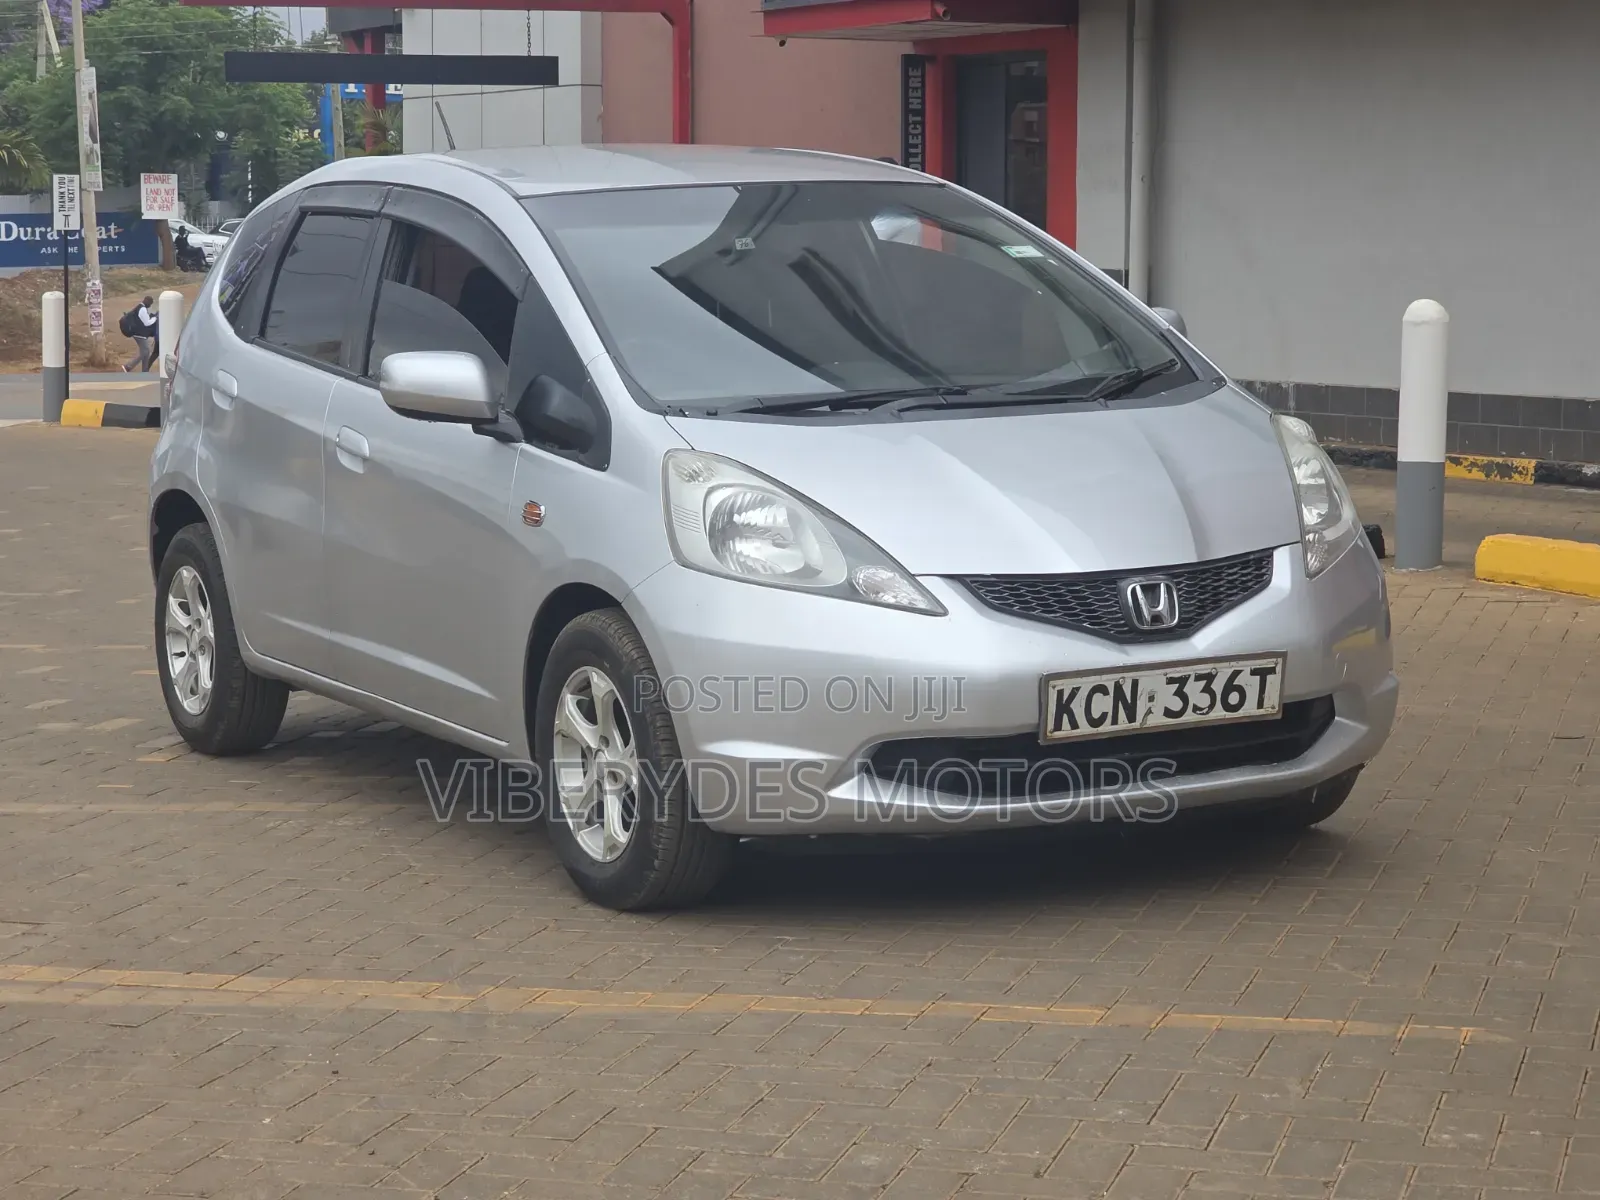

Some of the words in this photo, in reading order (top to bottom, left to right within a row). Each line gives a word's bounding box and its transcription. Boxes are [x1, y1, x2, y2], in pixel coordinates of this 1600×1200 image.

[909, 67, 922, 109] HERE
[909, 114, 922, 172] OLLECT
[58, 176, 66, 190] YOU
[143, 174, 172, 185] BEWARE
[67, 188, 75, 203] NEXT
[145, 187, 161, 196] LAND
[164, 188, 175, 196] NOT
[58, 191, 66, 212] THANK
[146, 196, 158, 204] FOR
[160, 196, 175, 205] SALE
[40, 246, 59, 254] ASK
[1053, 678, 1139, 732] KCN
[1163, 666, 1277, 720] 336T
